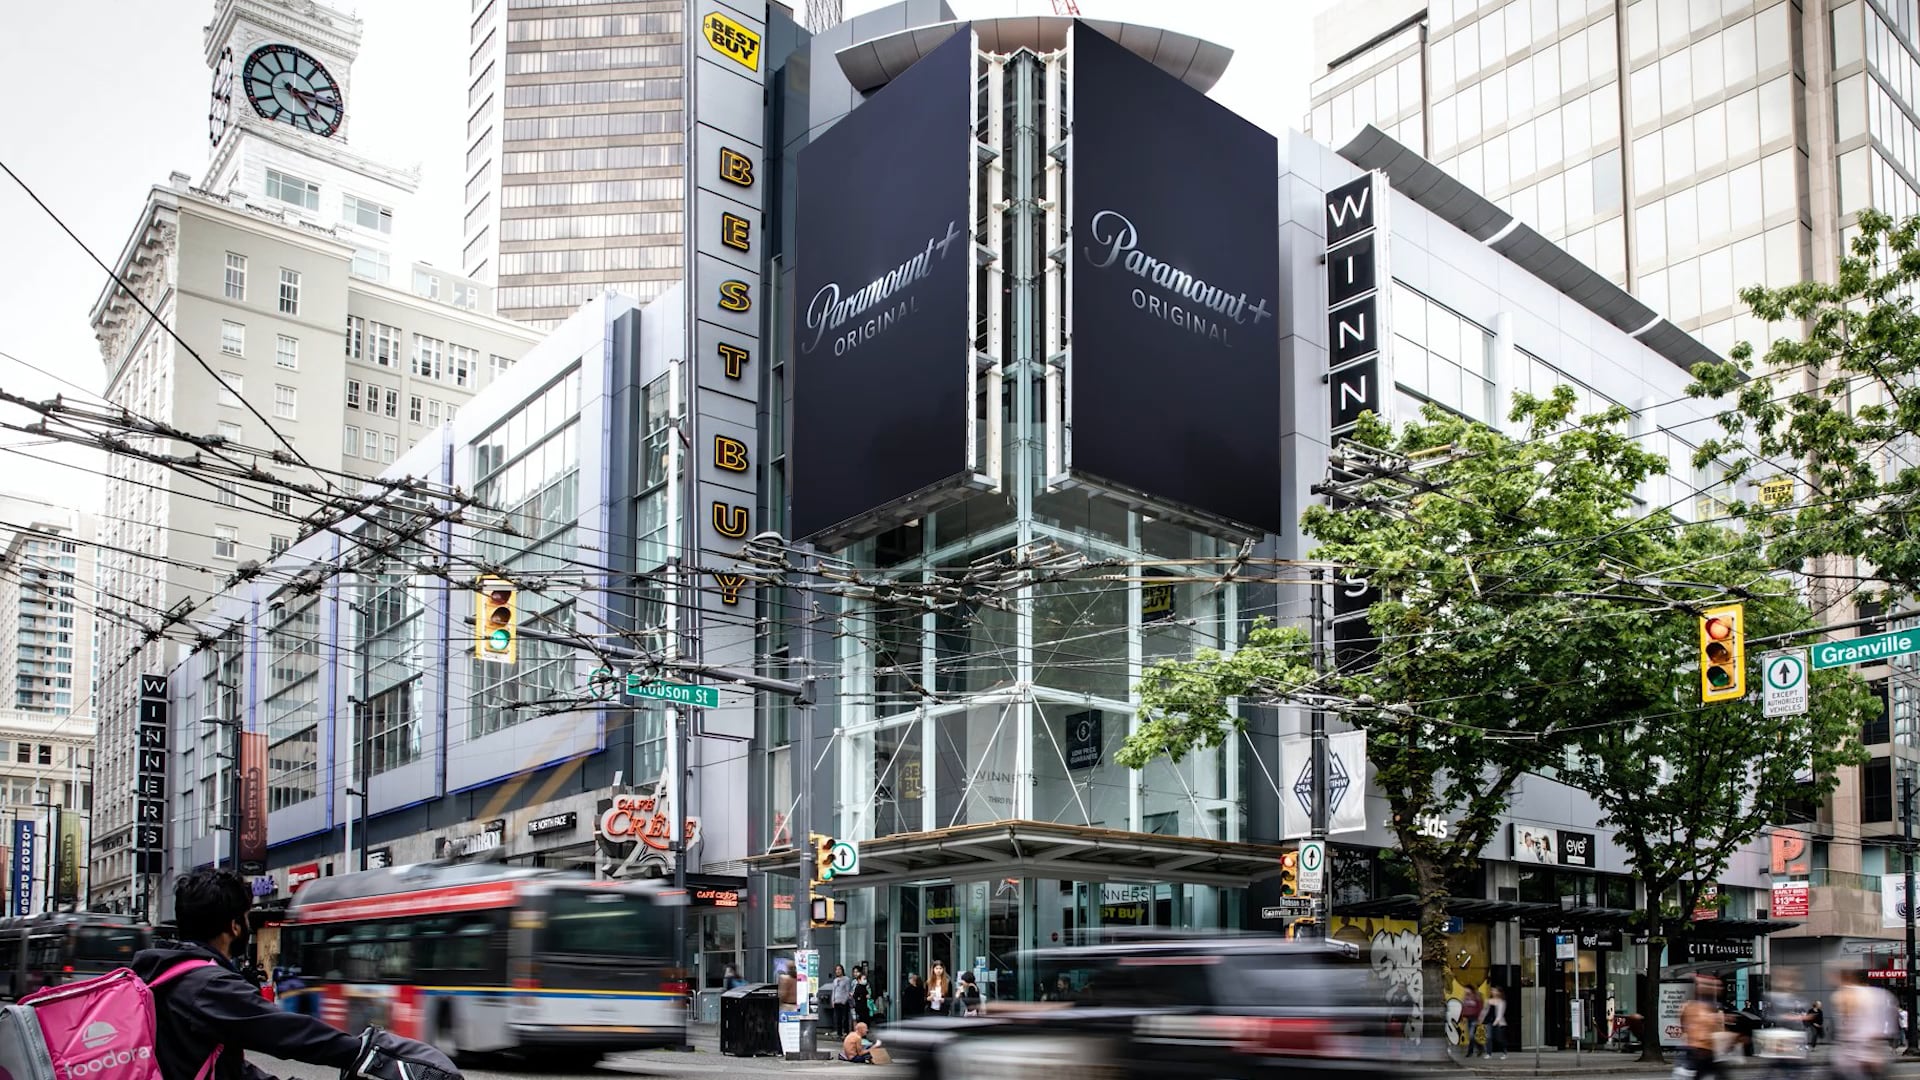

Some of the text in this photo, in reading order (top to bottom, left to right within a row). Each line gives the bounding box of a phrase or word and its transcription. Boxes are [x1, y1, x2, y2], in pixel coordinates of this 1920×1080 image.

[711, 17, 758, 51] BEST
[712, 30, 753, 60] BUY
[1084, 210, 1272, 325] Paramount+
[801, 220, 960, 354] Paramount+
[834, 296, 919, 357] ORIGINAL
[1131, 288, 1233, 348] ORIGINAL
[712, 147, 755, 605] BEST BUY
[1328, 185, 1369, 597] WINNS
[1763, 483, 1793, 494] BEST
[1821, 635, 1912, 665] Granville
[696, 689, 708, 704] St
[1768, 697, 1804, 706] AUTHORIZED
[1769, 704, 1801, 713] VEHICLES
[1772, 690, 1798, 698] EXCEPT
[142, 679, 167, 844] WINNERS
[555, 814, 567, 826] FACE
[606, 810, 697, 850] CRÊE
[21, 824, 31, 914] LONDON DRUGS
[1101, 889, 1149, 902] NNERS
[927, 907, 954, 919] BEST
[1118, 907, 1145, 919] BUY
[1688, 943, 1714, 954] CITY
[1867, 969, 1907, 977] FIVE GUYS
[64, 1045, 153, 1079] foodora
